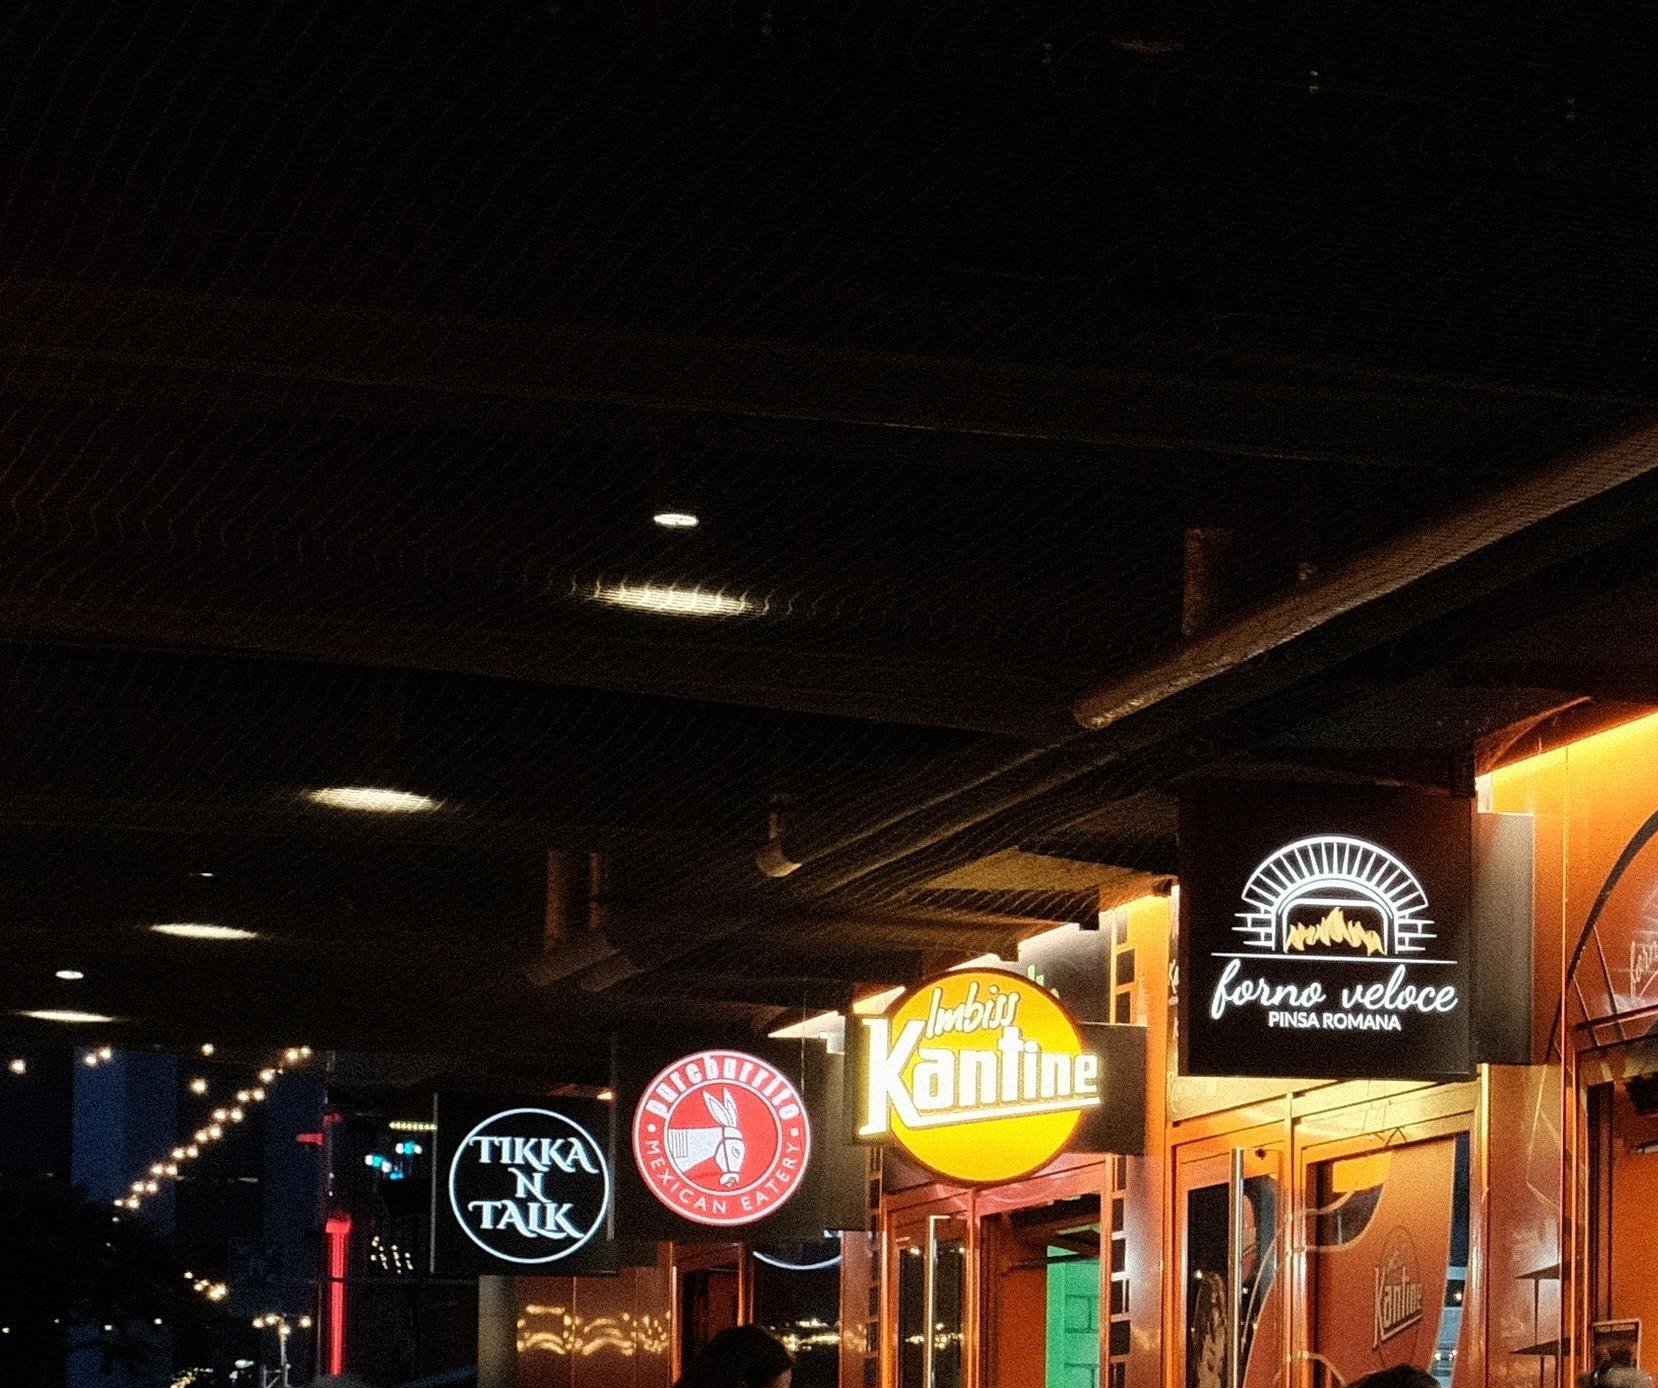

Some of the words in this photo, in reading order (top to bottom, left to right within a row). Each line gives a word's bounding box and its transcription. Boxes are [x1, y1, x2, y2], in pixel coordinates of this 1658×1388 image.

[926, 981, 1020, 1039] Imbiss
[1210, 958, 1327, 1021] forno
[1342, 963, 1459, 1012] veloce
[1268, 1010, 1320, 1029] PINSA
[1322, 1013, 1402, 1032] ROMANA
[645, 1055, 802, 1121] pureburrito
[858, 1017, 1101, 1136] Kantine
[468, 1136, 600, 1174] TIKKA
[507, 1167, 552, 1203] N
[646, 1139, 728, 1215] MEXICAN
[741, 1142, 801, 1212] EATERY
